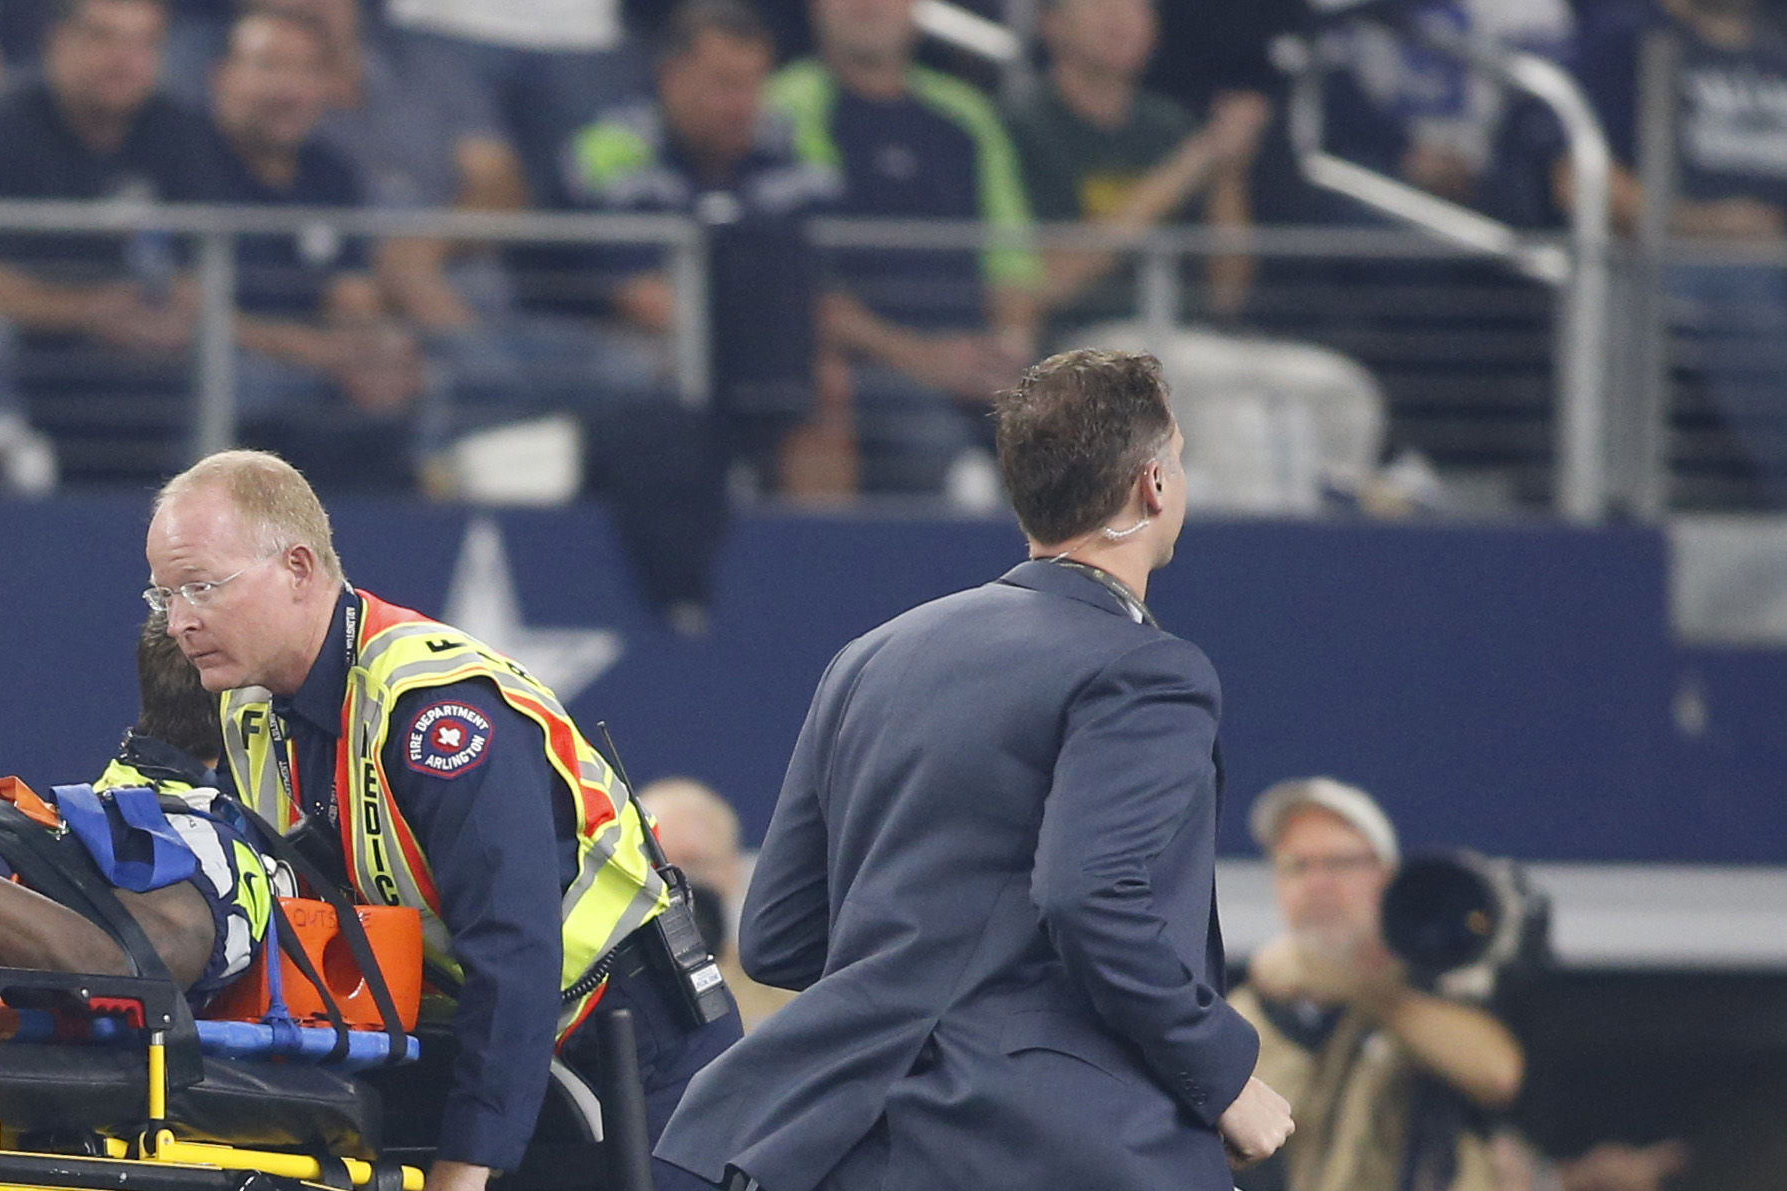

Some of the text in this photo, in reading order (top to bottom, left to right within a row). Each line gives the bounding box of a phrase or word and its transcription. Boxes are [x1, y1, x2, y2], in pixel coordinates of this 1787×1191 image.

[268, 698, 283, 742] ARLING
[410, 705, 489, 761] FIRE DEPARTMENT
[425, 735, 486, 770] ARLINGTON
